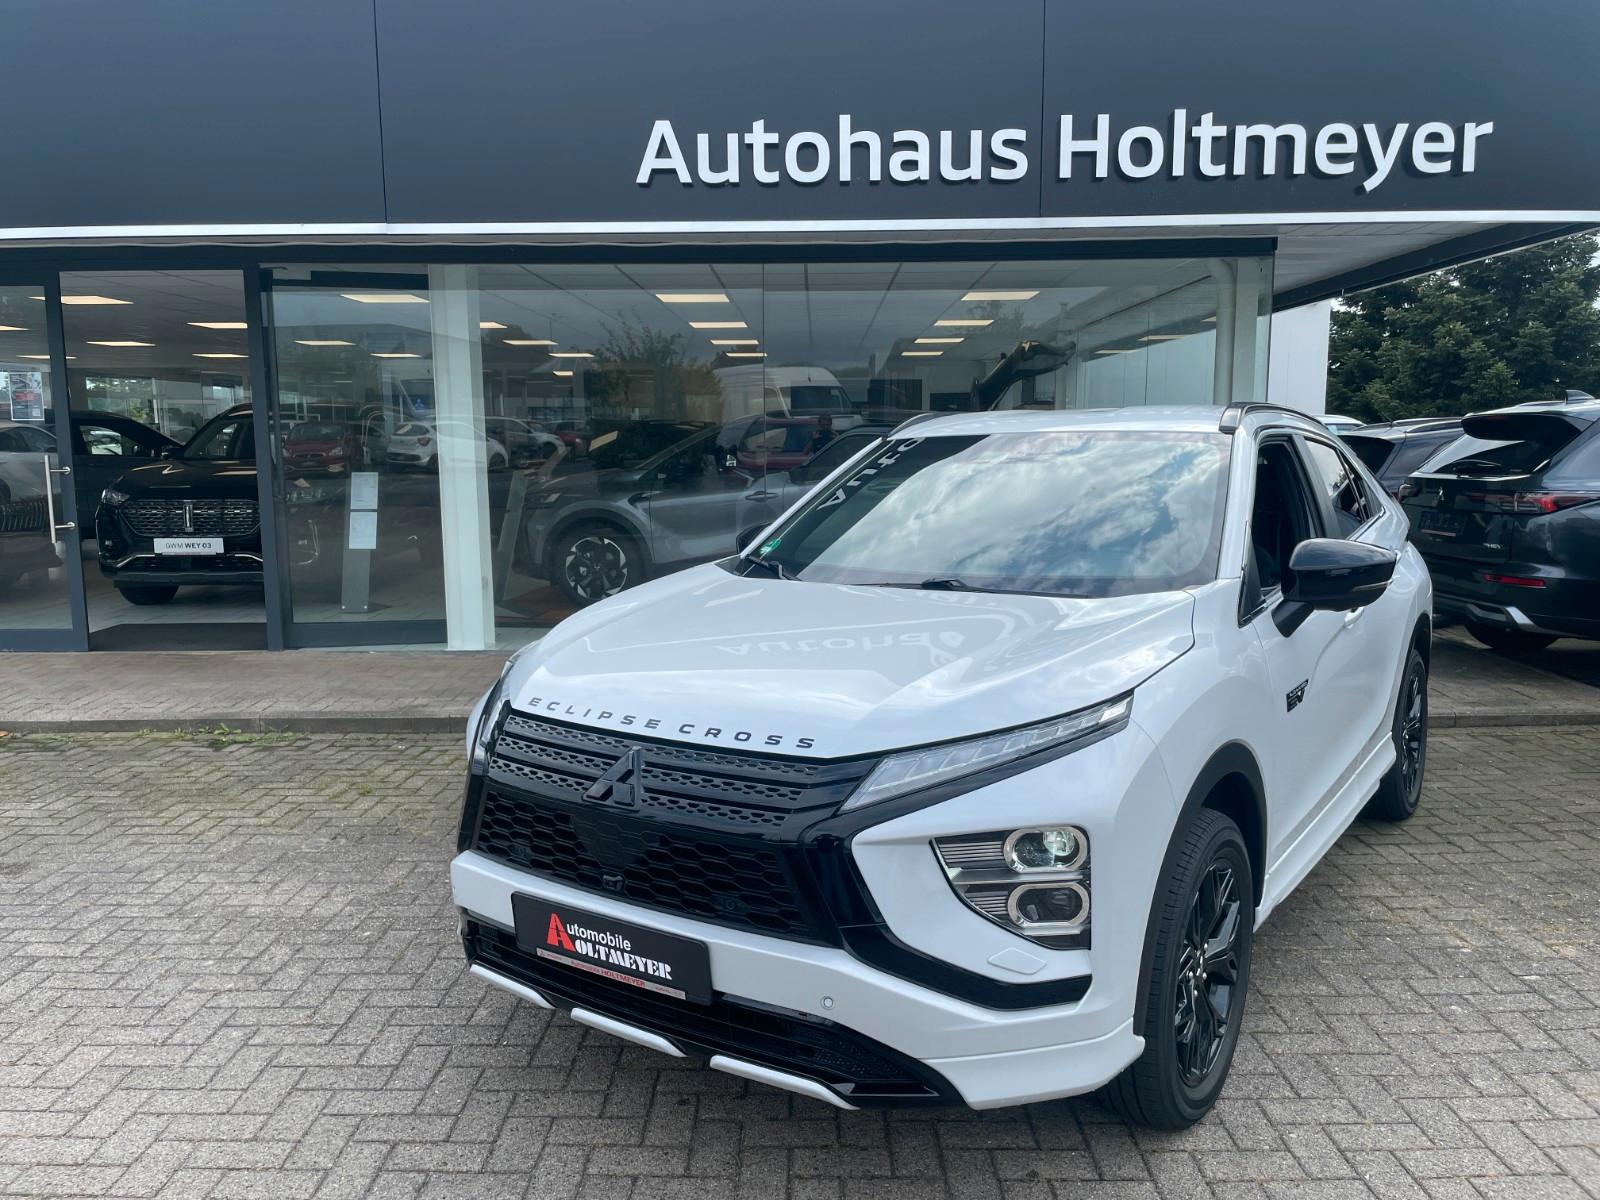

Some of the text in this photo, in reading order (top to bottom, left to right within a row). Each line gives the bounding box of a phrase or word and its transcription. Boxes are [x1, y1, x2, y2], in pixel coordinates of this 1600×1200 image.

[636, 108, 1494, 193] Autohaus Holtmeyer
[184, 542, 201, 550] WEY
[527, 696, 816, 749] ECLIPSE CROSS
[547, 911, 632, 952] Automobile
